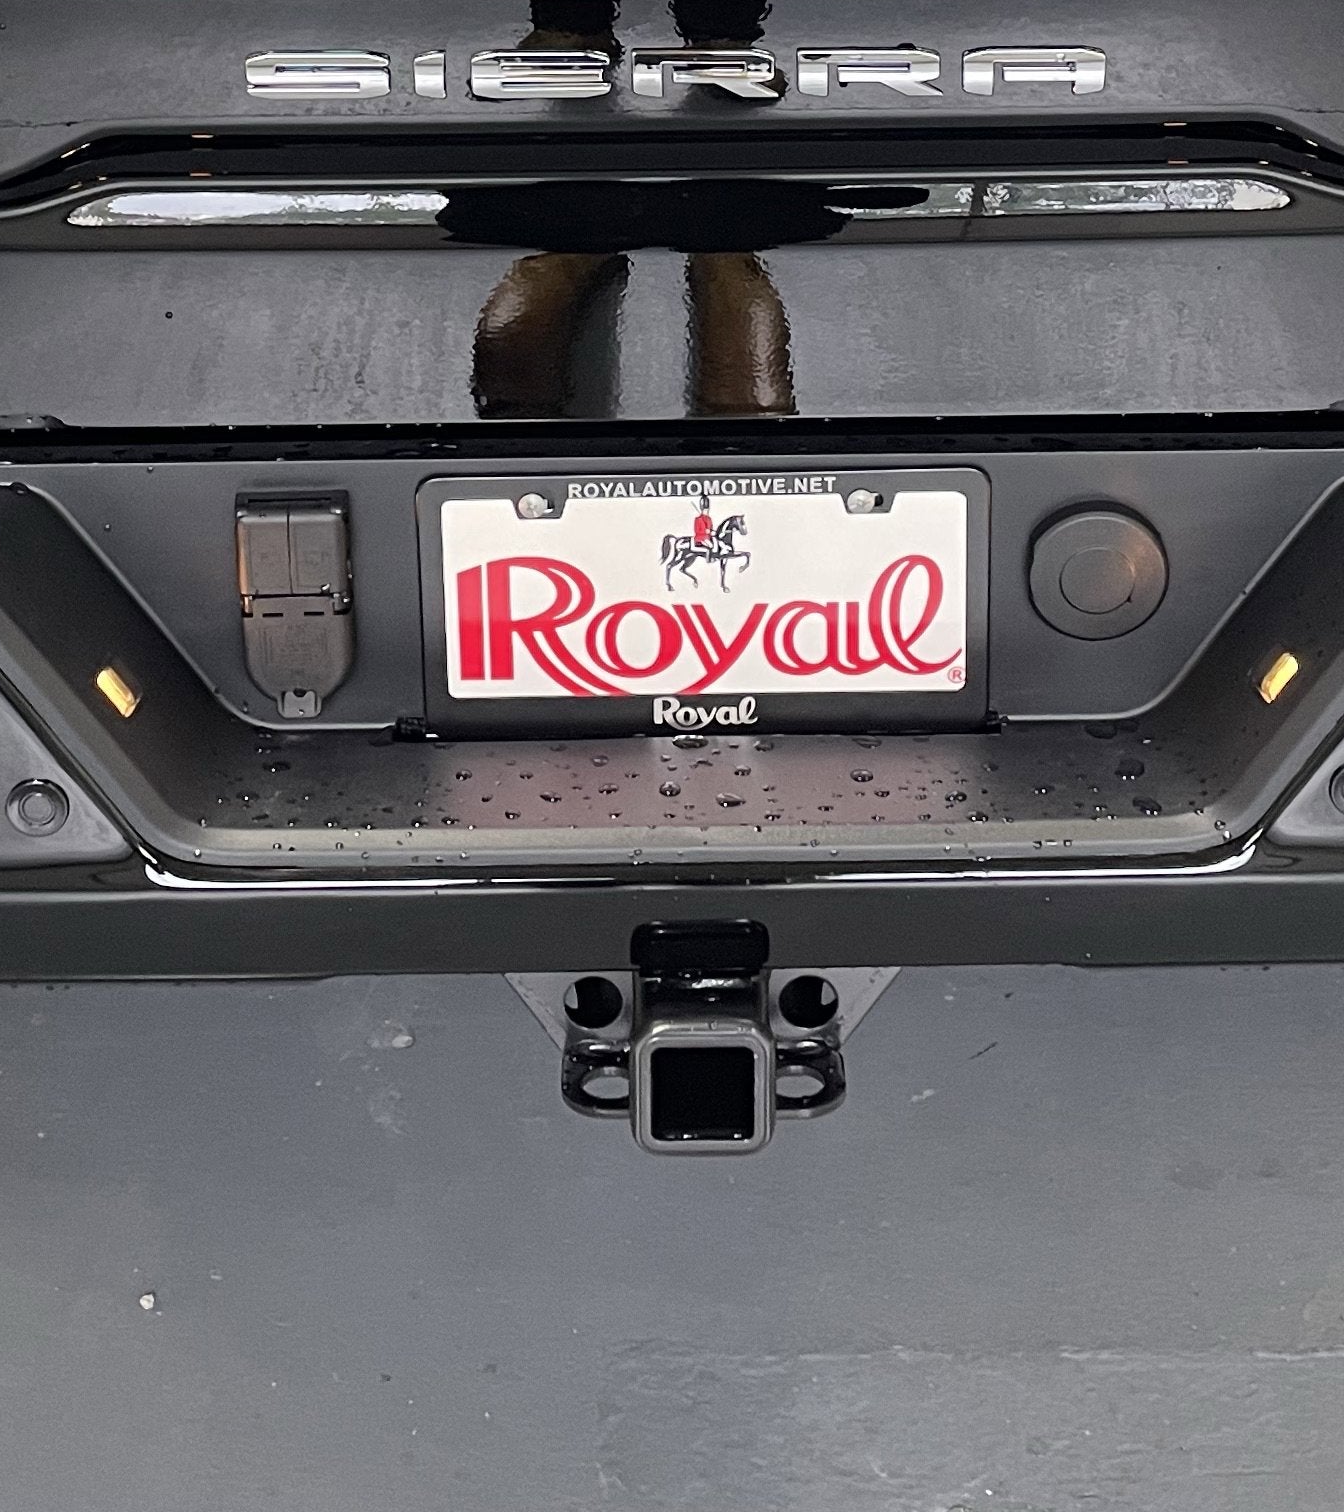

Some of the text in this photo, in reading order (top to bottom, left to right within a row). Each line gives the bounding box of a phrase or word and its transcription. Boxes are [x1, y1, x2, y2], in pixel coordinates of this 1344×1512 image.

[244, 45, 1107, 100] SIERRA
[568, 476, 837, 499] ROYALAUTOMOTIVE.NET
[457, 555, 962, 696] Royal
[653, 696, 758, 731] Royal
